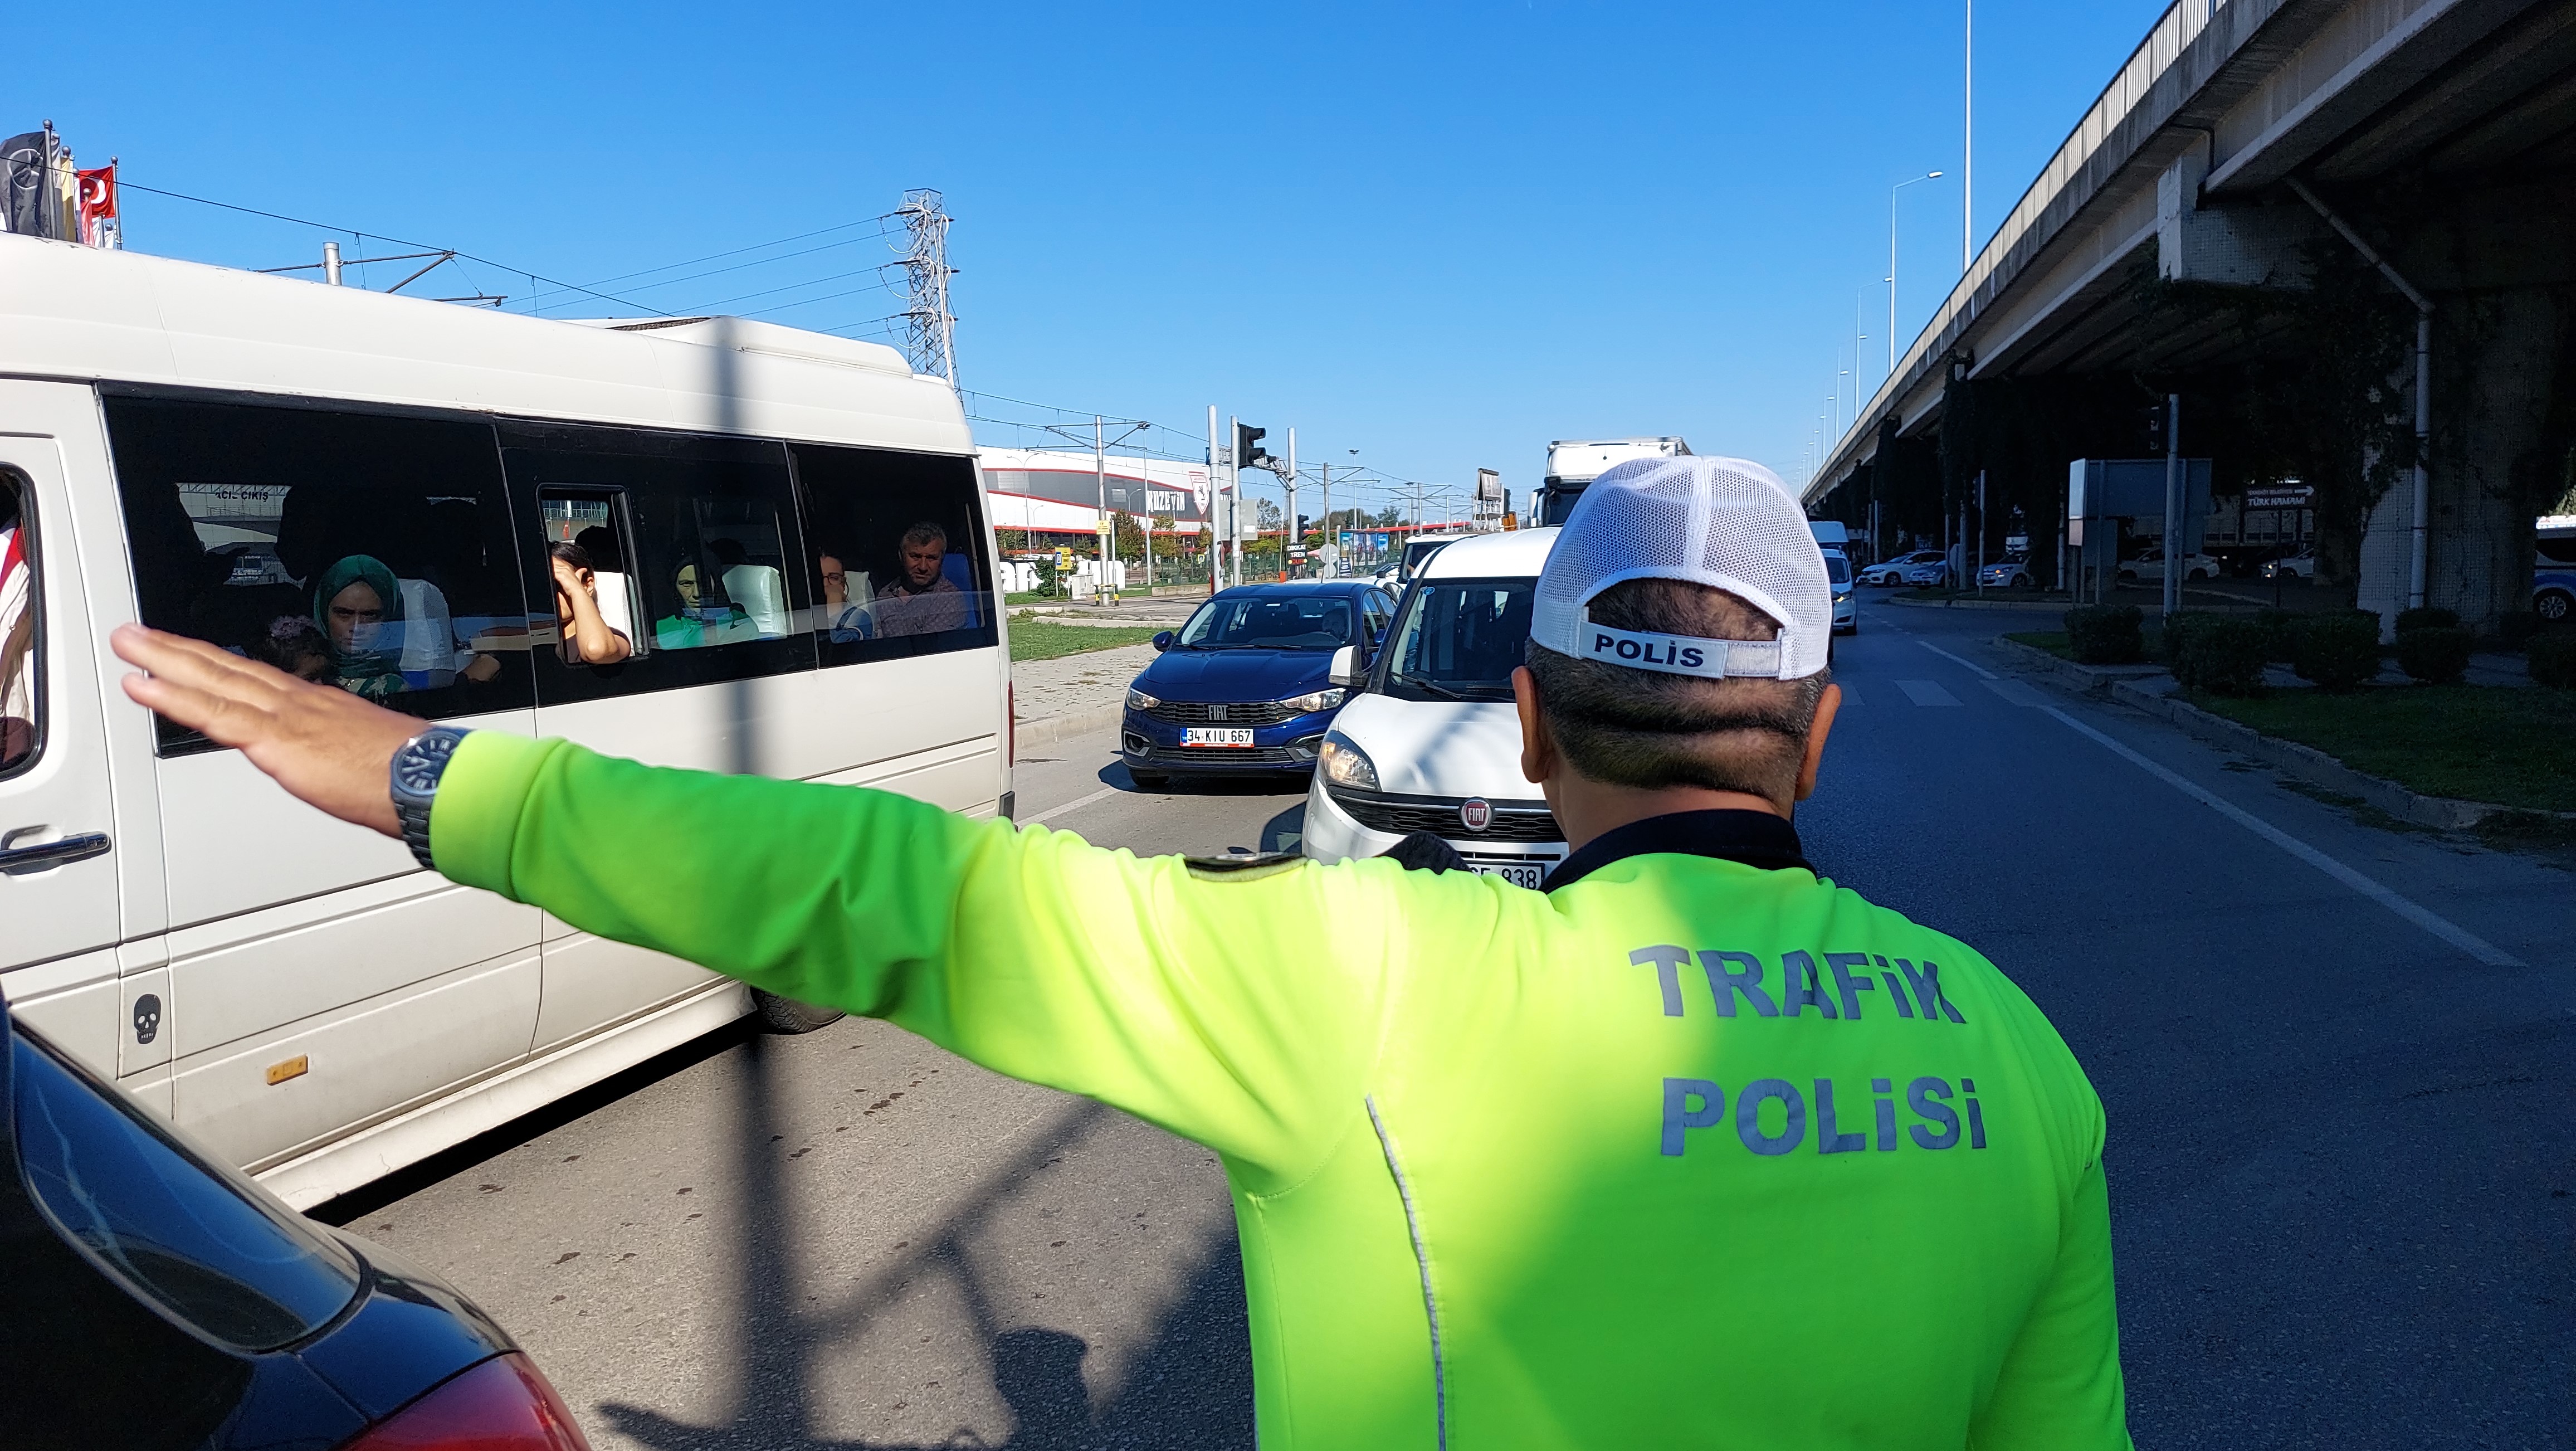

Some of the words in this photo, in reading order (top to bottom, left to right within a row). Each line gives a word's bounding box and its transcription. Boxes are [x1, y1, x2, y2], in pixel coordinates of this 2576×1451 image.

[2247, 497, 2270, 507] TÜRK
[1594, 633, 1704, 668] POLİS
[1208, 705, 1228, 720] FIAT
[1188, 730, 1201, 742] 34
[1206, 730, 1225, 742] KIU
[1231, 730, 1251, 742] 667
[1468, 807, 1486, 821] FIAT
